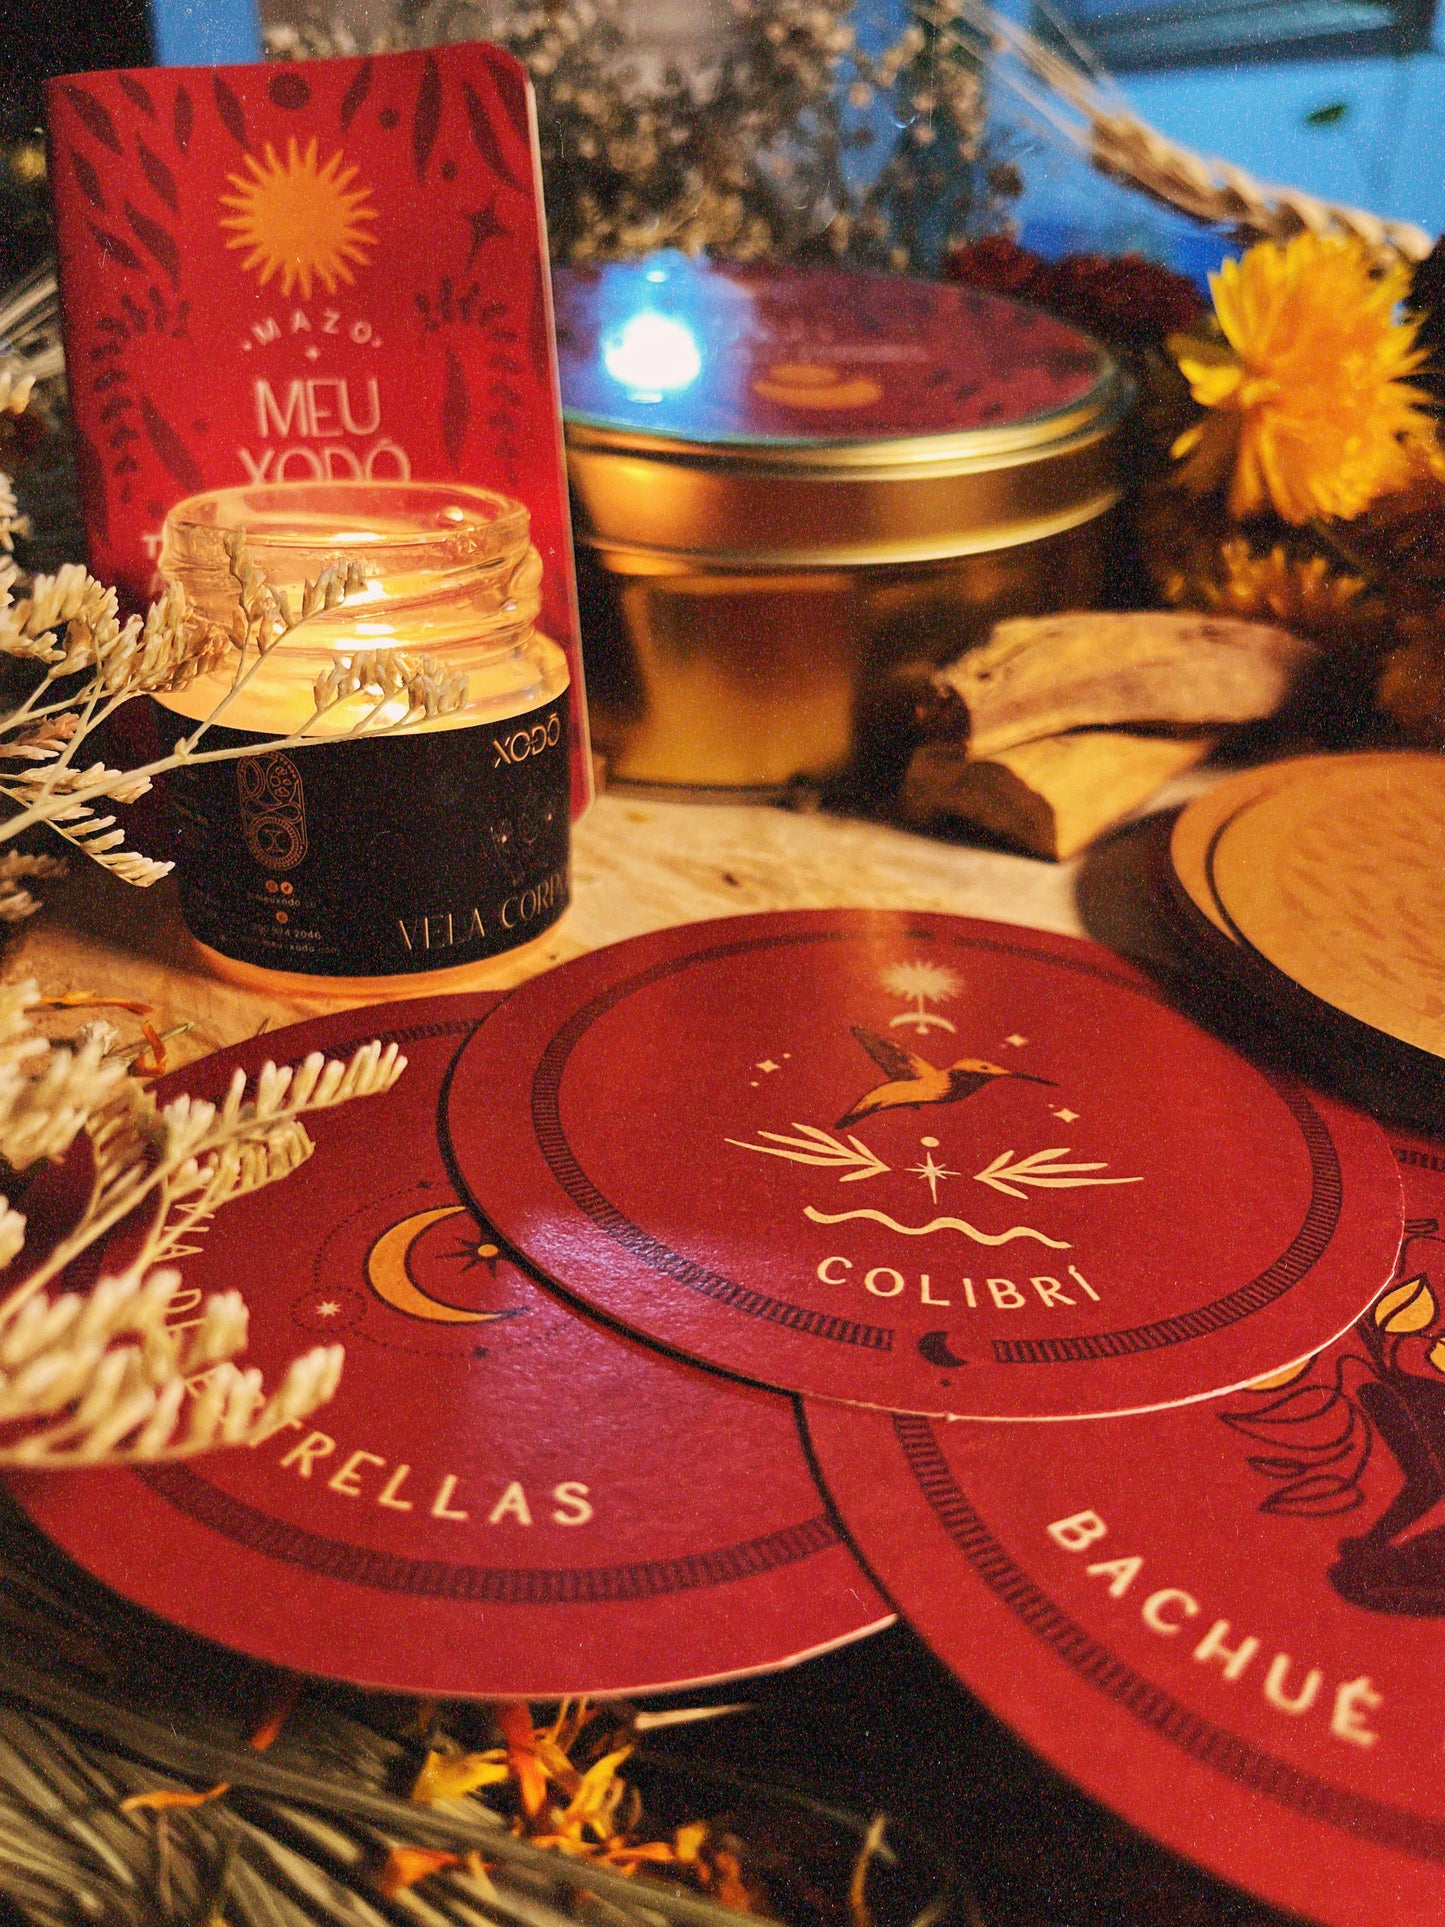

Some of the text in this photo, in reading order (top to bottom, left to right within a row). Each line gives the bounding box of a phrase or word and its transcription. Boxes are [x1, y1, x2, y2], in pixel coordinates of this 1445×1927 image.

[251, 309, 373, 345] MAZO
[255, 376, 381, 438] MEU
[399, 907, 486, 950] VELA
[816, 1256, 1101, 1309] COLIBRÍ
[1047, 1509, 1383, 1747] BACHUÉ
